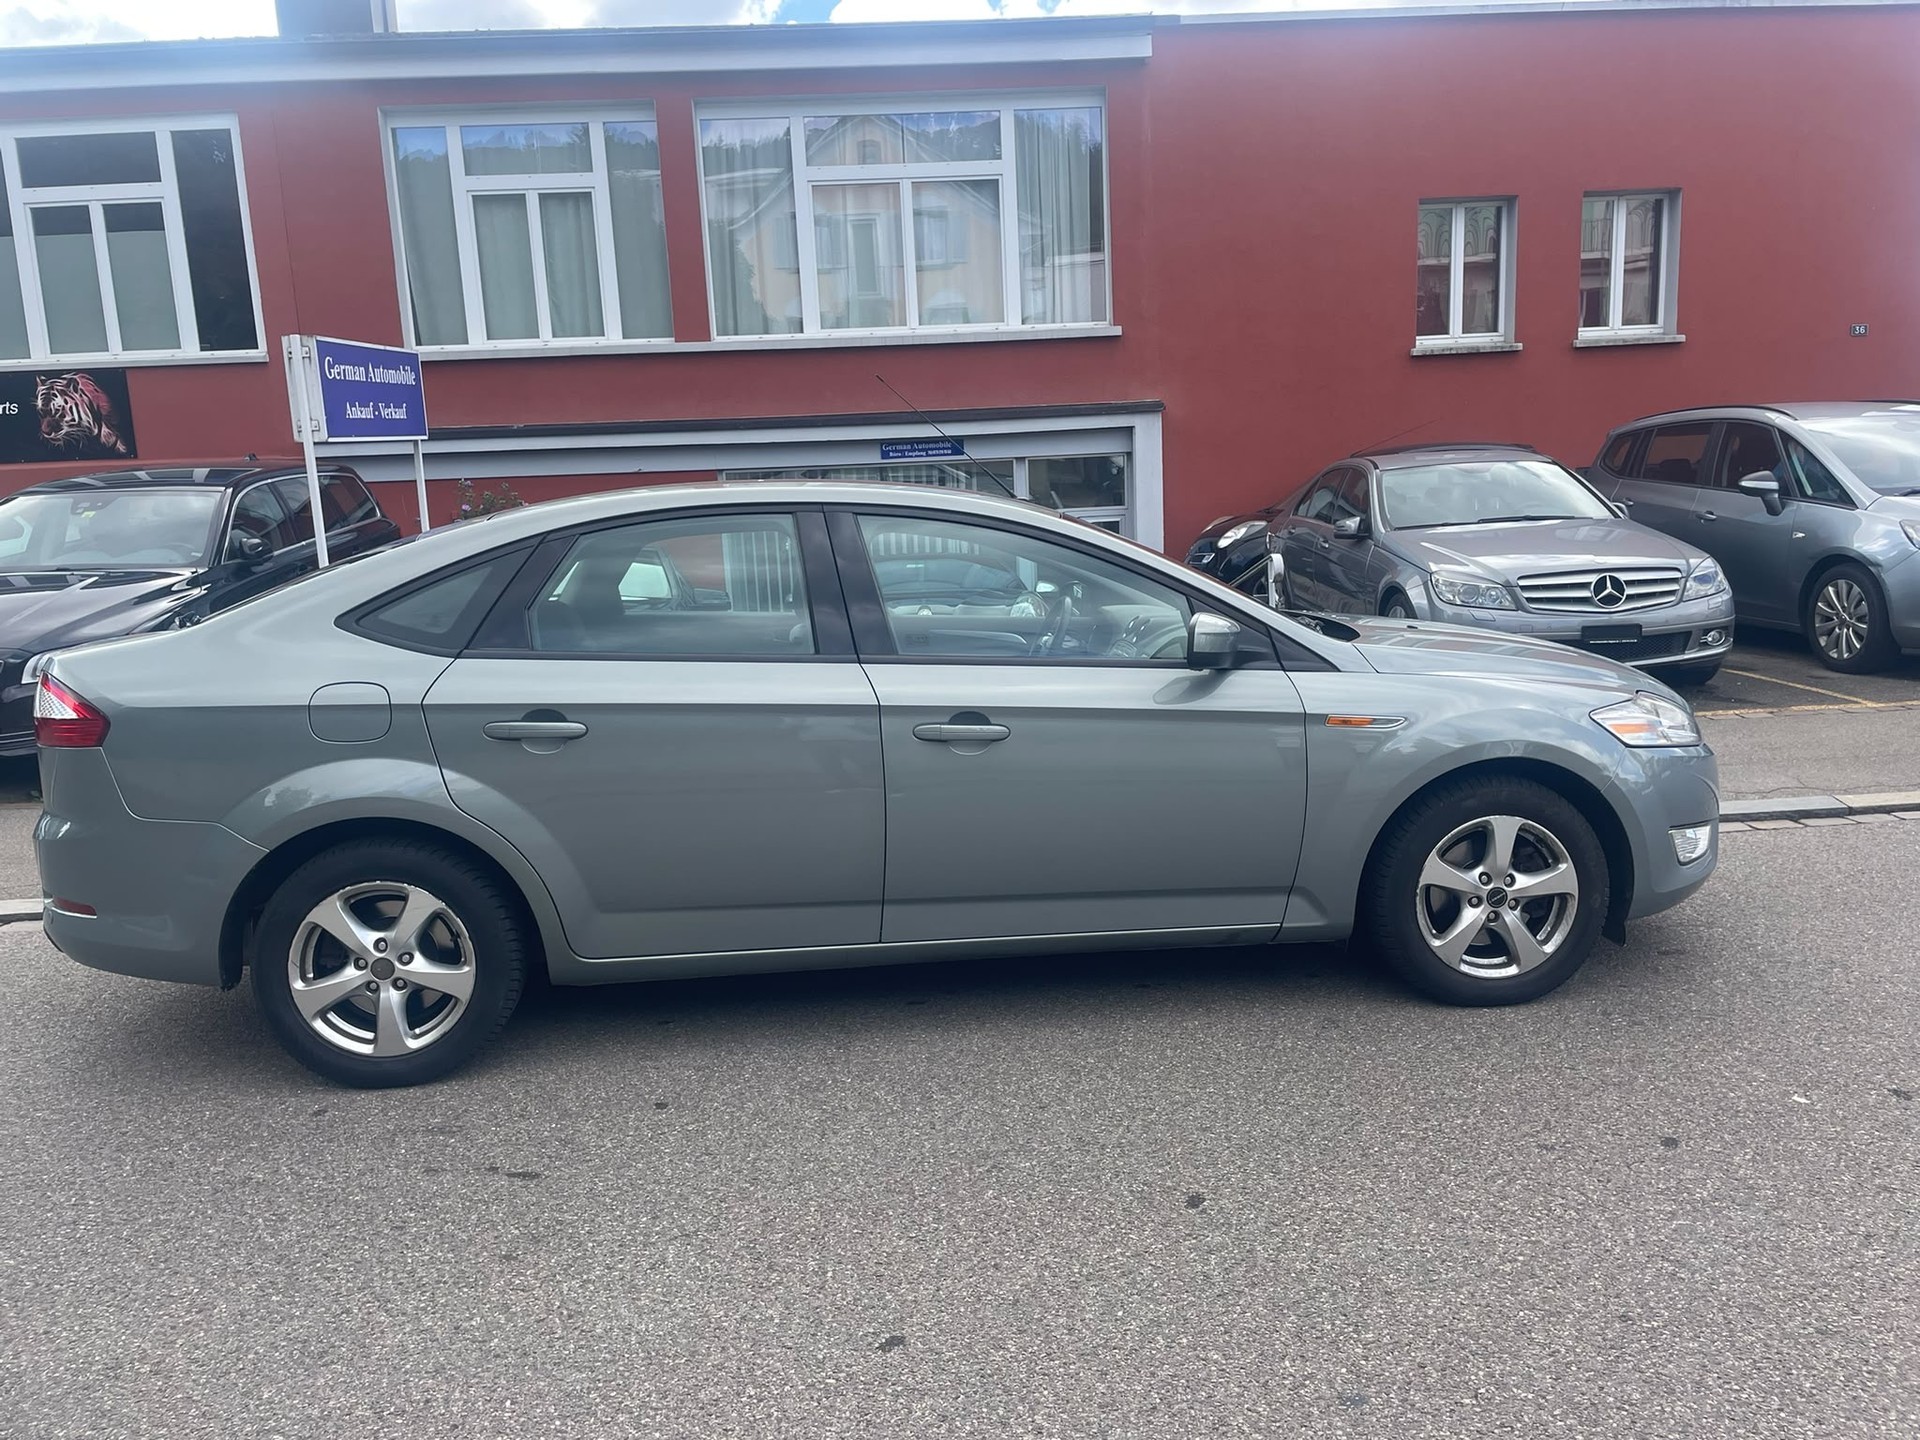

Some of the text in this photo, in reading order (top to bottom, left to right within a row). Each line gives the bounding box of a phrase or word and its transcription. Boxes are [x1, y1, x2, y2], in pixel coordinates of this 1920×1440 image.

[1854, 326, 1866, 334] 36
[325, 356, 416, 385] German Automobile
[346, 402, 374, 418] Ankauf
[379, 403, 407, 419] Verkauf
[882, 441, 952, 451] German Automobile
